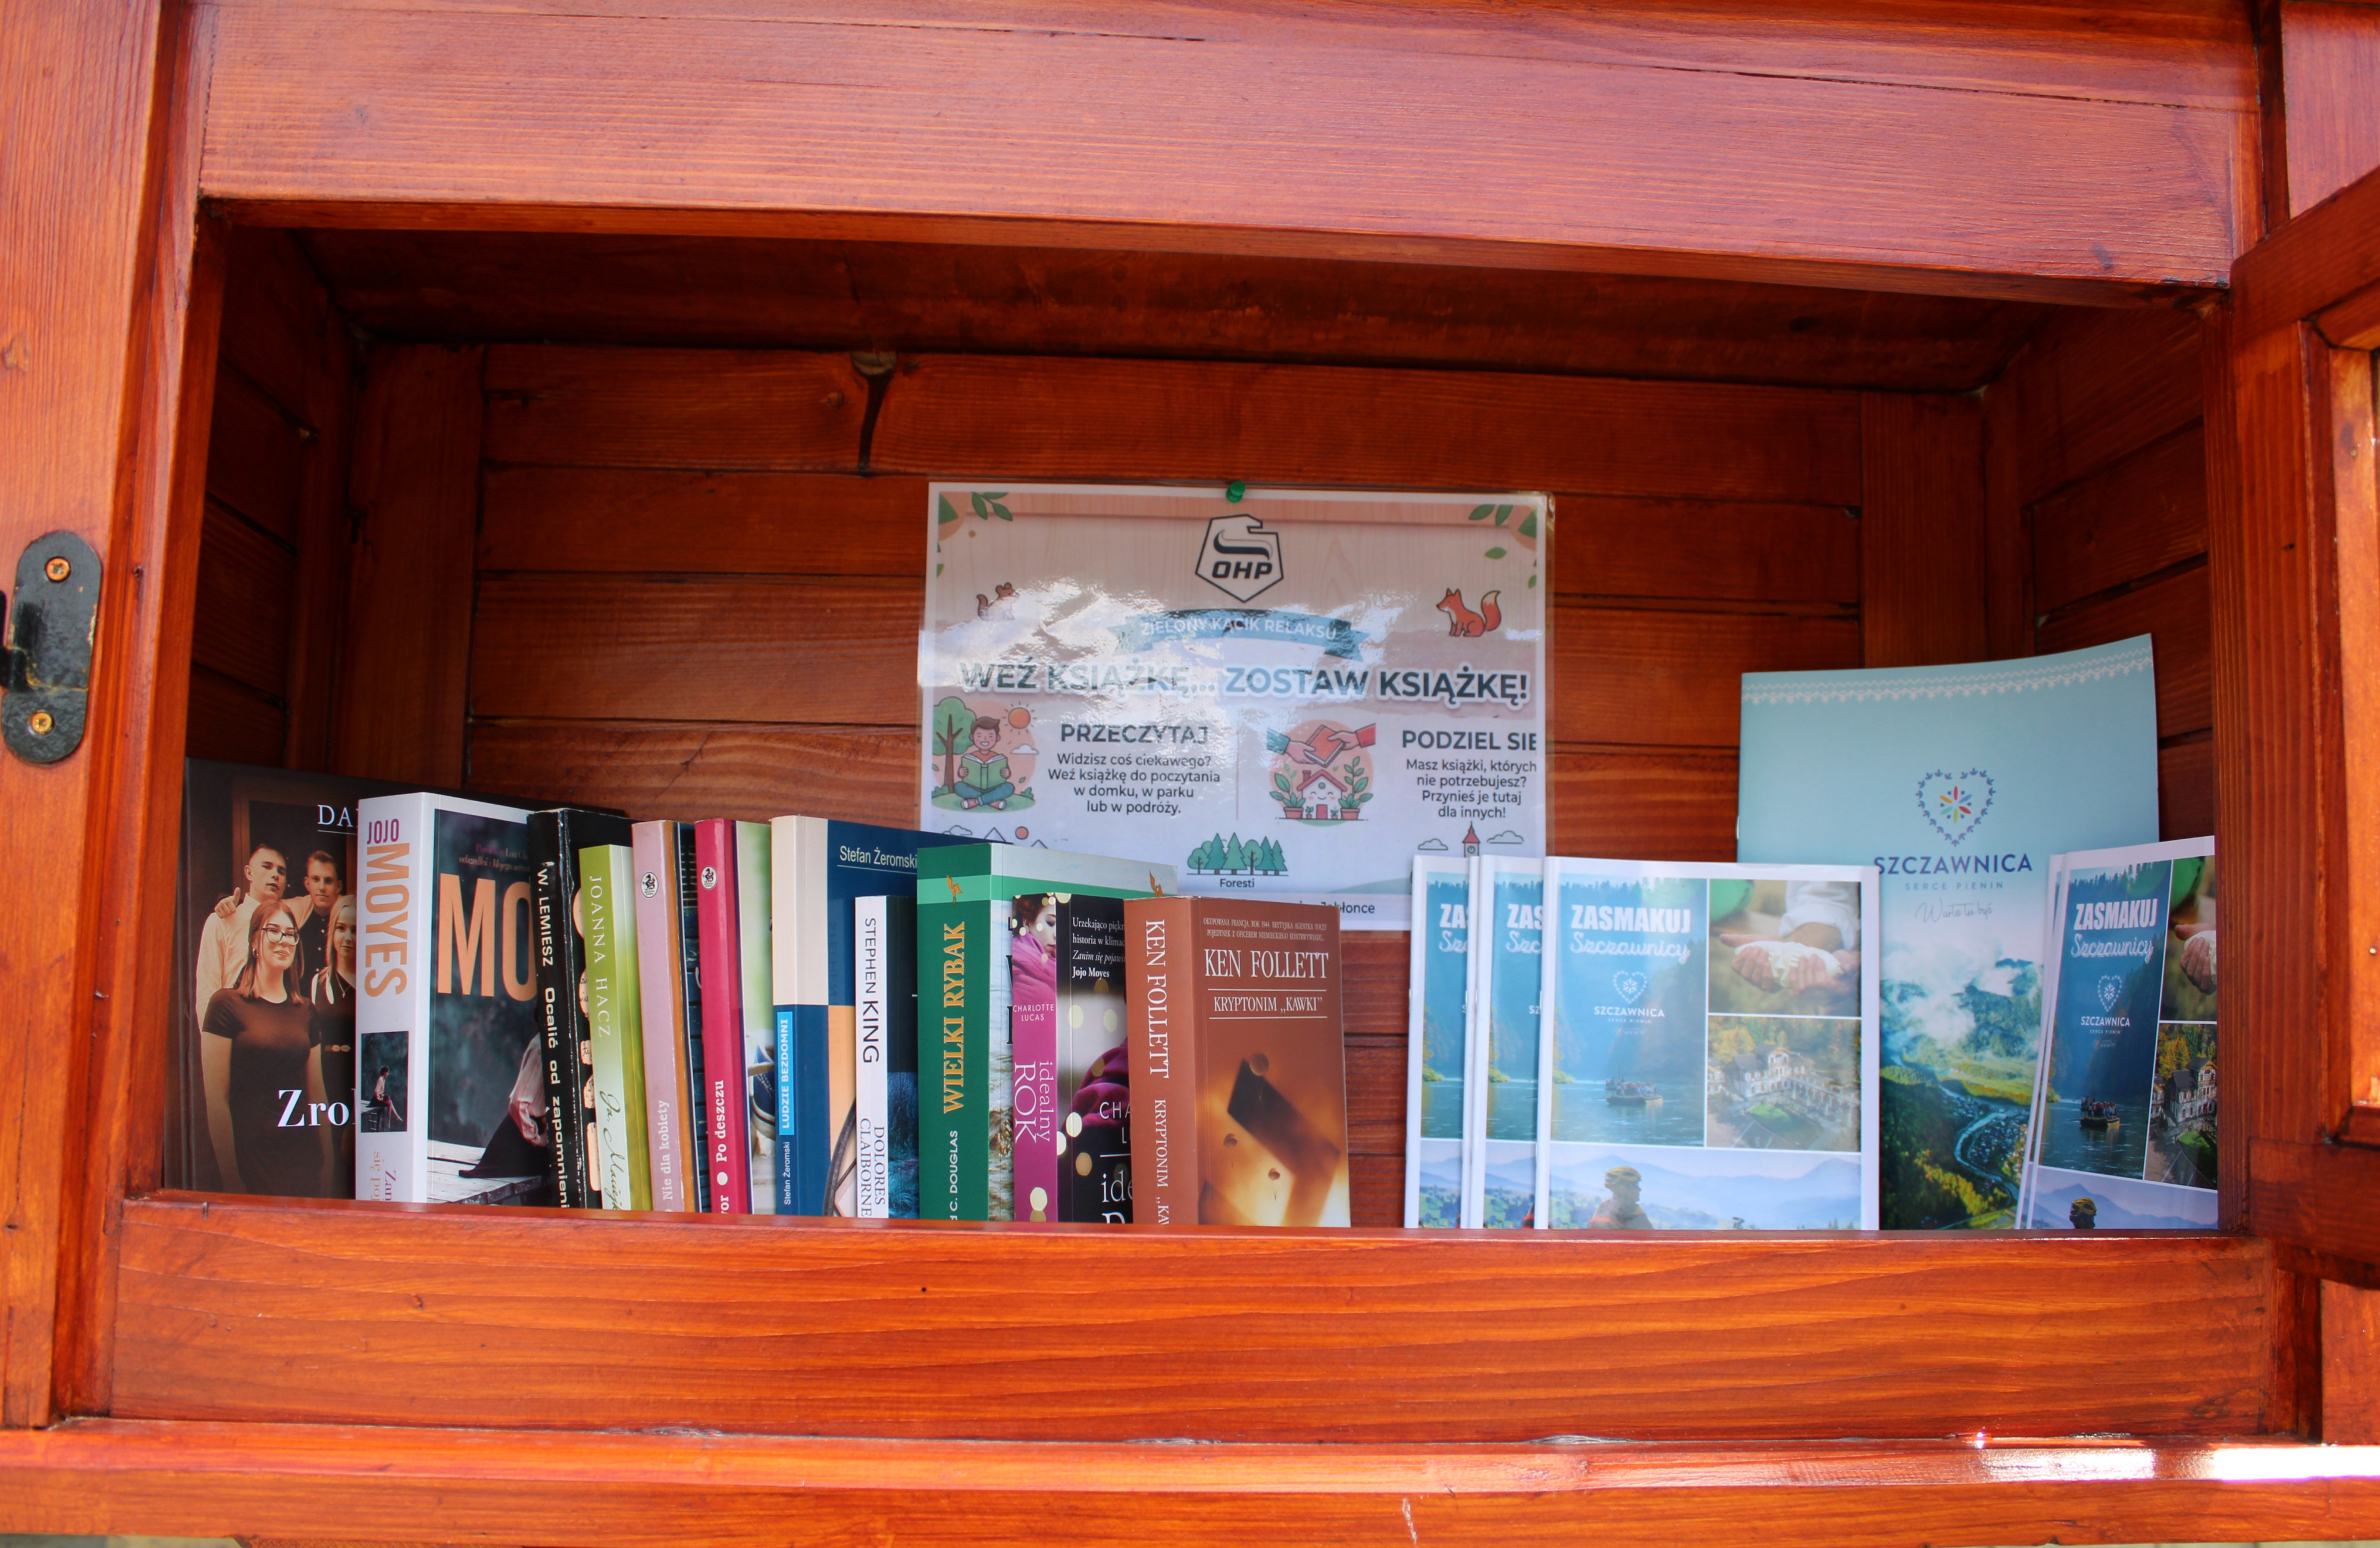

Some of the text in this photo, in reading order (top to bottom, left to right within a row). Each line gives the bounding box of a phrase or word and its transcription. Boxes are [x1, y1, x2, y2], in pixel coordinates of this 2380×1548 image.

[1211, 561, 1273, 579] OHP
[1141, 619, 1207, 636] ZIELONY
[1264, 619, 1337, 640] RELAKSU
[959, 656, 1037, 688] WEŹ
[1225, 667, 1368, 696] ZOSTAW
[1380, 665, 1527, 706] KSIĄŻKĘ!
[1061, 724, 1208, 744] PRZECZYTAJ
[1402, 730, 1501, 750] PODZIEL
[1057, 753, 1211, 769] Widzisz coś ciekawego?
[1406, 759, 1536, 774] Masz książki, których
[1048, 768, 1220, 784] Weź książkę do poczytania
[1417, 774, 1526, 789] nie potrzebujesz?
[1074, 785, 1194, 800] w domku, w parku
[1423, 790, 1521, 805] Przynieś je tutaj
[318, 804, 358, 828] DA
[1087, 800, 1181, 815] lub w podróży.
[1438, 806, 1506, 820] dla innych!
[367, 818, 400, 845] JOJO
[840, 845, 917, 868] Stefan Żeromski
[1874, 853, 2033, 875] SZCZAWNICA
[537, 868, 549, 892] W.
[1220, 878, 1255, 888] Foresti
[1905, 881, 2003, 891] SERCE PIENIN
[365, 842, 410, 997] MOYES
[1072, 917, 1107, 931] Urzekająco
[1203, 917, 1230, 927] OKUPOWANA
[1571, 904, 1691, 934] ZASMAKUJ
[2074, 899, 2158, 931] ZASMAKUJ
[539, 896, 553, 967] LEMIESZ
[1072, 933, 1097, 945] historia
[1146, 920, 1166, 967] KEN
[1207, 929, 1231, 939] POJEDYNEK
[590, 875, 611, 1037] JOANNA HACZ
[1072, 950, 1094, 961] Zanim
[1570, 931, 1690, 965] Szczawnicy
[2071, 933, 2153, 964] Szczawnicy
[943, 921, 965, 1008] RYBAK
[1072, 966, 1110, 980] Jojo Moyes
[1204, 949, 1329, 978] KEN FOLLETT
[862, 918, 879, 1064] STEPHEN KING
[1013, 1003, 1054, 1012] CHARLOTTE
[1214, 997, 1277, 1012] KRYPTONIM
[1593, 1006, 1665, 1018] SZCZAWNICA
[545, 987, 558, 1049] Ocalić
[1147, 974, 1169, 1079] FOLLETT
[2080, 1016, 2131, 1027] SZCZAWNICA
[780, 1019, 789, 1083] BEZDOMNI
[550, 1060, 560, 1084] od
[943, 1016, 965, 1114] WIELKI
[277, 1089, 355, 1127] Zro
[715, 1080, 726, 1139] deszczu
[781, 1085, 790, 1129] LUDZIE
[1014, 1061, 1036, 1144] ROK
[1036, 1061, 1054, 1142] idealny
[658, 1100, 673, 1200] Nie dla kobiety
[716, 1144, 727, 1162] Po
[1155, 1099, 1169, 1188] KRYPTONIM
[370, 1151, 385, 1172] się
[860, 1118, 872, 1216] CLAIBORNE
[874, 1126, 885, 1205] DOLORES
[949, 1130, 959, 1193] DOUGLAS
